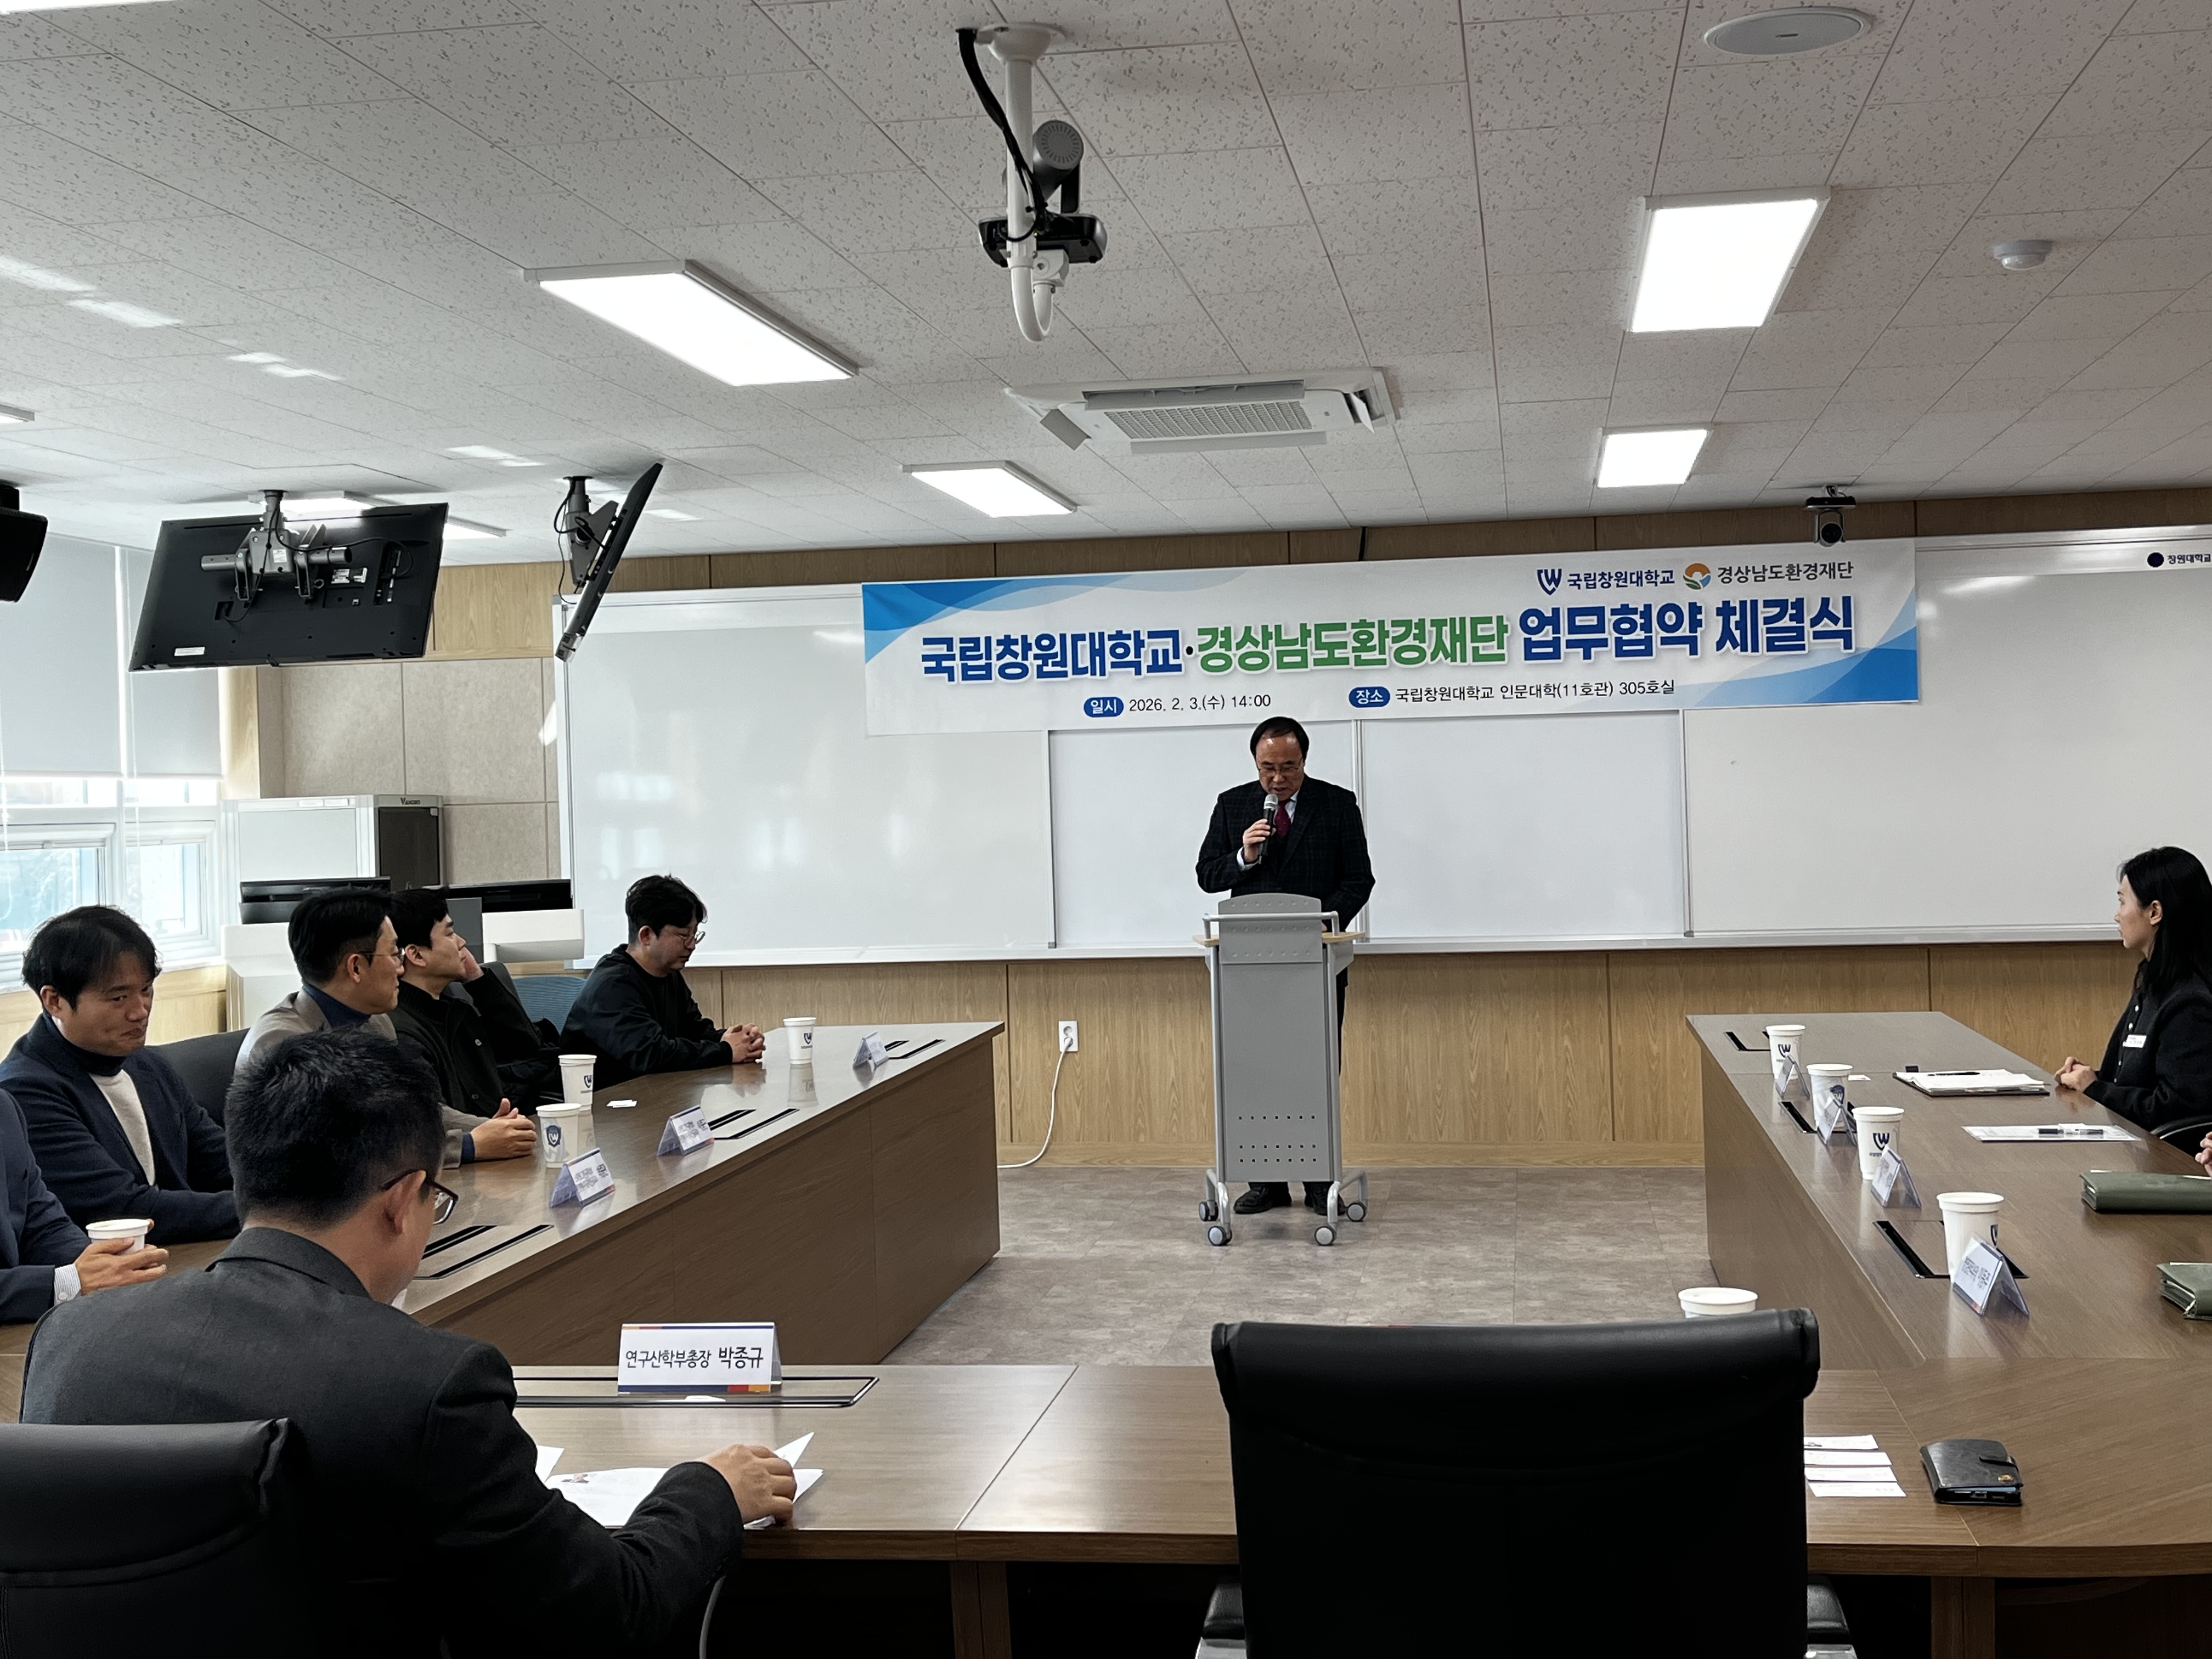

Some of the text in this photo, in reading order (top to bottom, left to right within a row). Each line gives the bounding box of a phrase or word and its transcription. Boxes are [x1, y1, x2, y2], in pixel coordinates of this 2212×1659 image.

[2168, 553, 2211, 565] 창원대학교
[1567, 570, 1675, 590] 국립창원대학교
[1718, 561, 1854, 584] 경상남도환경재단
[1519, 601, 1703, 661] 업무협약
[1715, 595, 1854, 654] 체결식
[1356, 679, 1674, 704] 장소 국립창원대학교 인문대학(11호관) 305호실
[1090, 699, 1118, 714] 일시
[1129, 698, 1166, 712] 2026.
[1172, 698, 1184, 711] 2.
[1231, 695, 1271, 708] 14:00
[625, 1347, 764, 1369] 연구산학부총장 박종규
